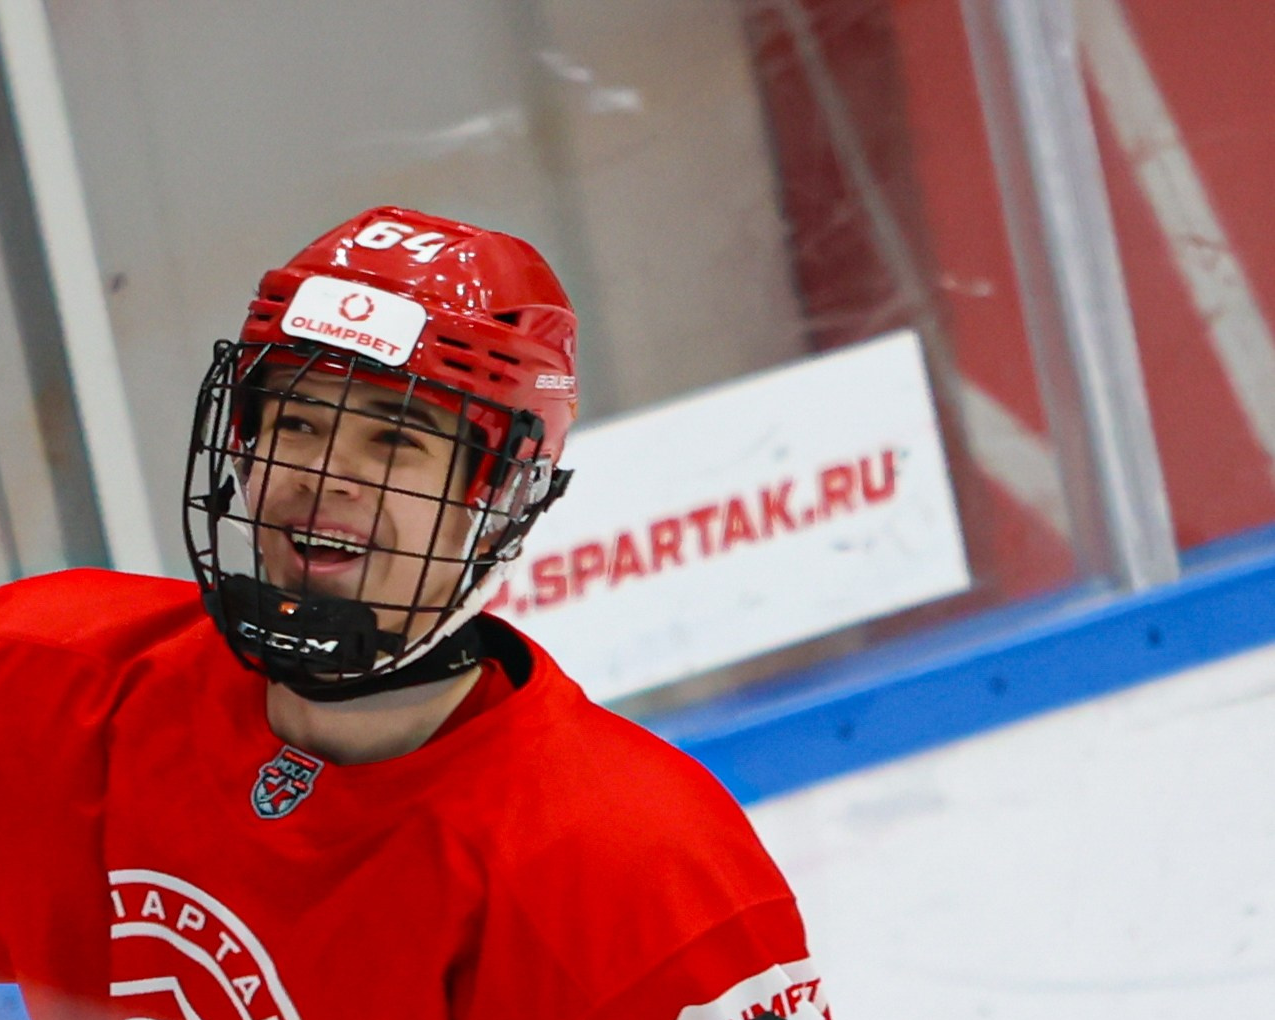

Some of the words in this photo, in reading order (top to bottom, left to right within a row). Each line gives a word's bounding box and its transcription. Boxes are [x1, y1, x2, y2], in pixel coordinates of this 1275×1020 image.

[353, 220, 446, 263] 64
[291, 316, 401, 357] OLIMPBET
[482, 449, 897, 616] .SPARTAK.RU
